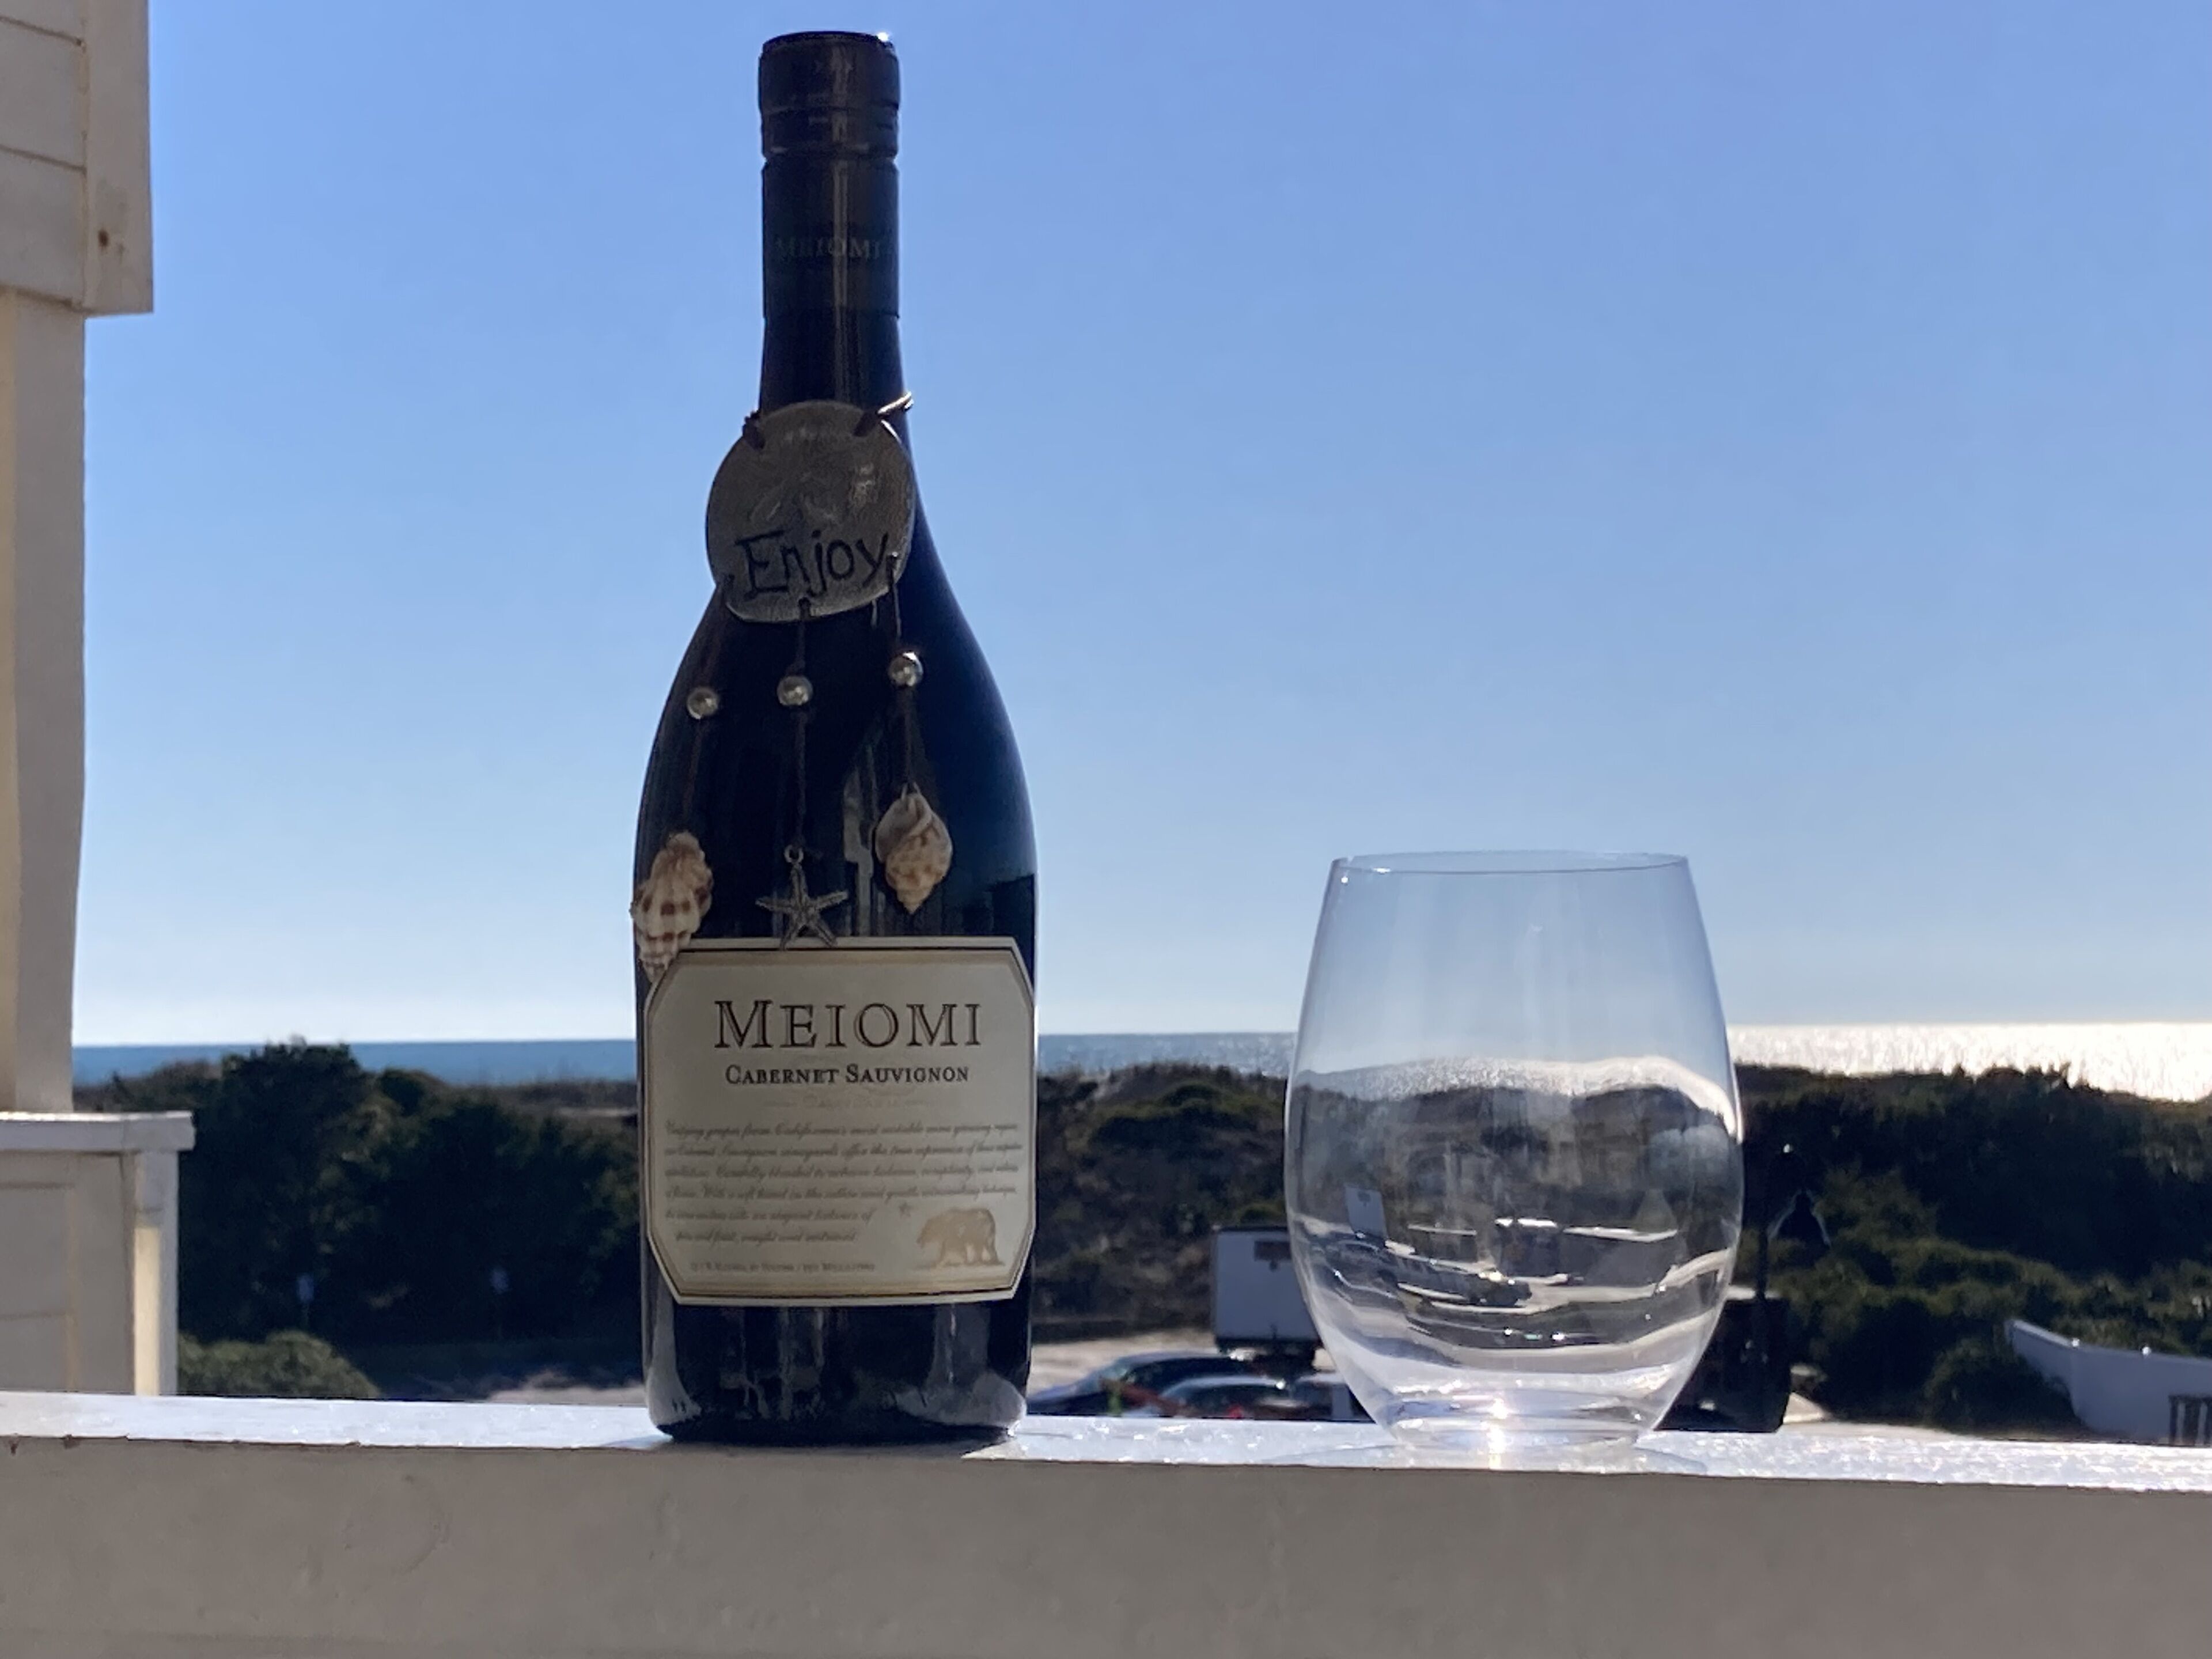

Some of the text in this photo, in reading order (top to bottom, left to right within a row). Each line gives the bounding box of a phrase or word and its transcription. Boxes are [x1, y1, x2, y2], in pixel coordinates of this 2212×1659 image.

[735, 528, 889, 600] Enjoy
[714, 999, 982, 1048] MEIOMI
[725, 1063, 969, 1084] CABERNET SAUVIGNON
